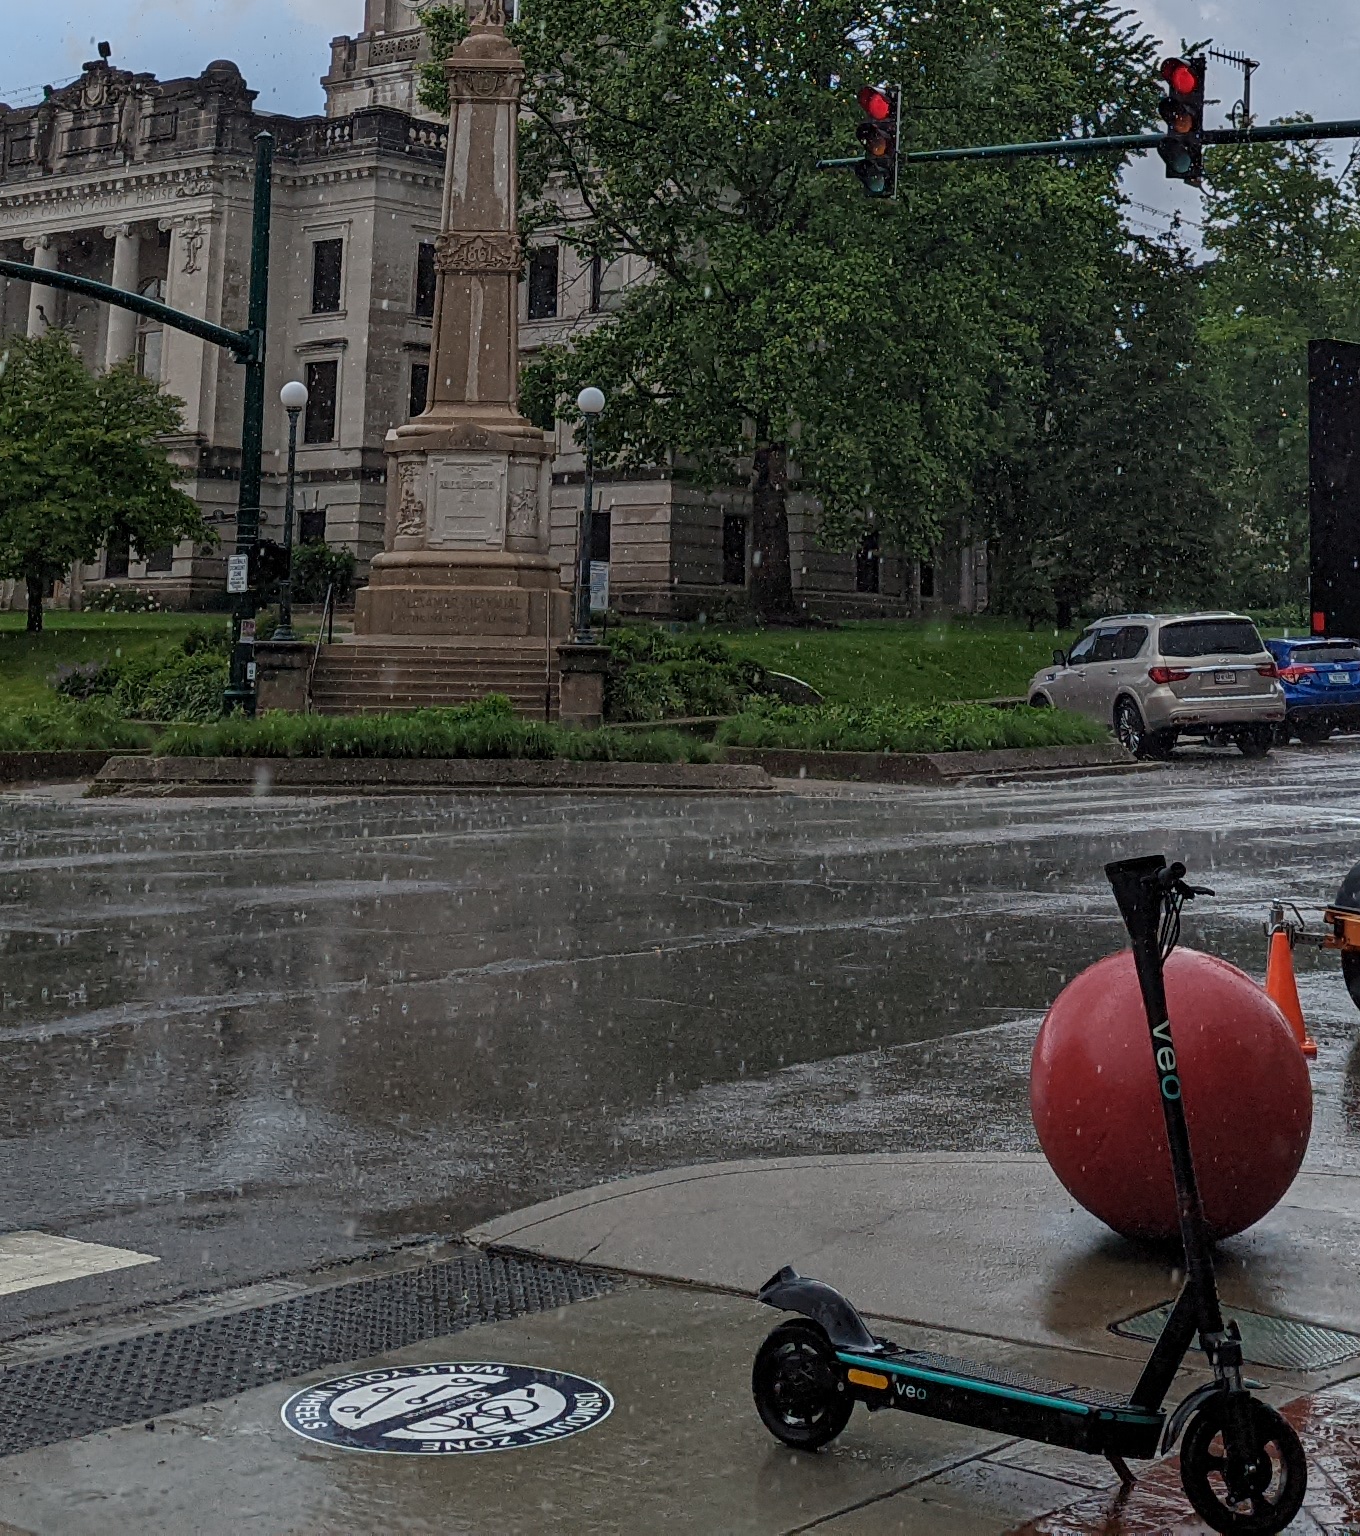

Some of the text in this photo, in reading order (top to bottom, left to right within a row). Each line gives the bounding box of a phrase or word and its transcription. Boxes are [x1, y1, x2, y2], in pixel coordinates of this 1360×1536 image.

[41, 200, 87, 218] COUNTY
[91, 193, 130, 210] COURT
[136, 186, 174, 205] HOUSE
[463, 244, 493, 262] 1861
[1153, 1019, 1181, 1100] veo
[295, 1365, 506, 1430] WALK YOUR WHEELS
[895, 1382, 927, 1400] veo
[522, 1392, 603, 1442] DISMOUNT
[420, 1435, 518, 1452] ZONE
